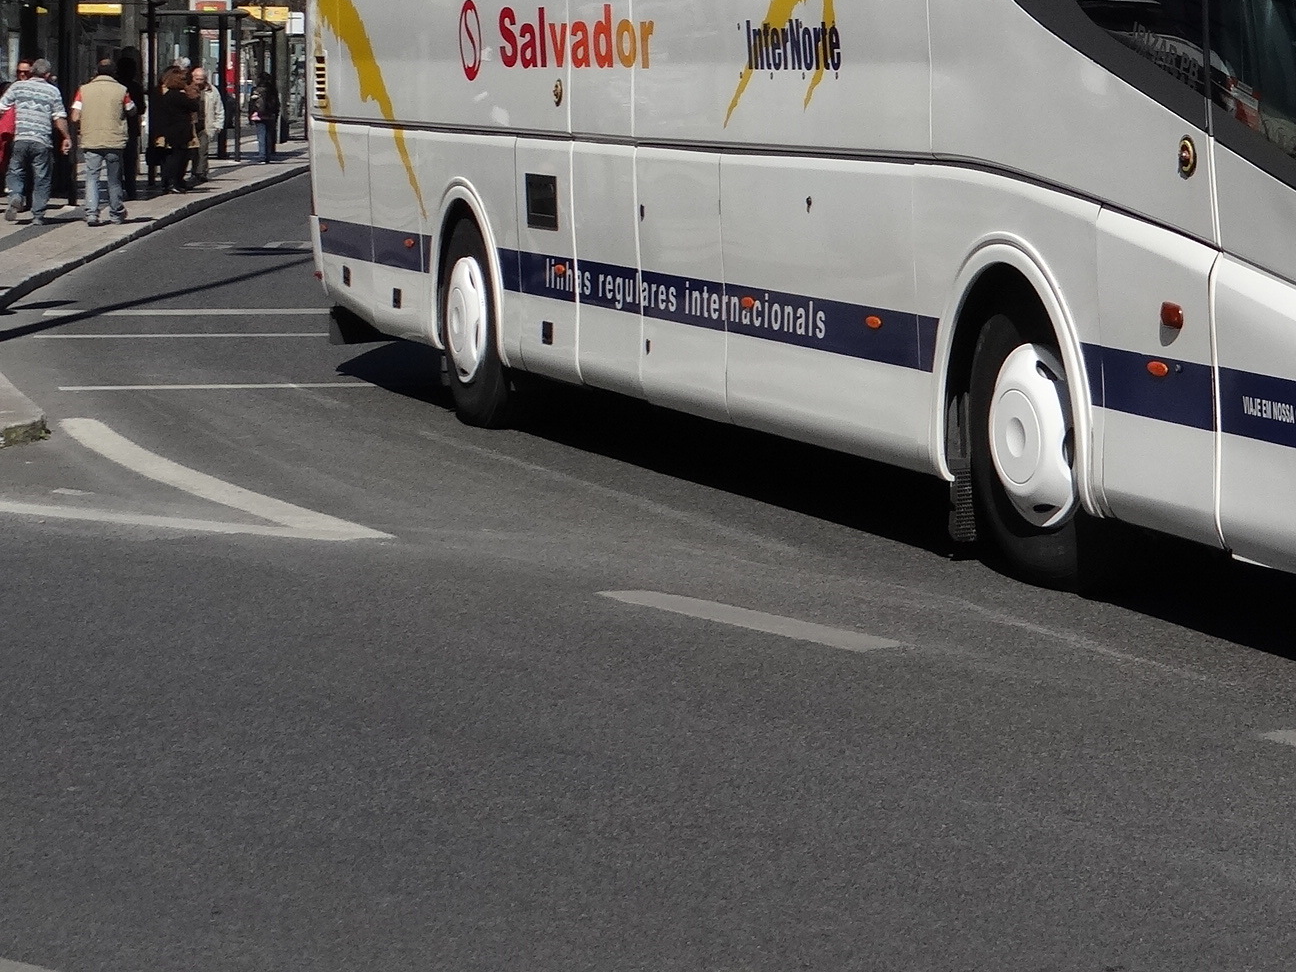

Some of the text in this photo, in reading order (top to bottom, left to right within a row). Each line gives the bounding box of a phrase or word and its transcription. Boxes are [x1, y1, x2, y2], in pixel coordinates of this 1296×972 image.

[499, 4, 655, 70] Salvador
[746, 18, 842, 72] InterNorte
[545, 258, 826, 339] linhas regulares internacionals
[1242, 395, 1261, 416] VIAJE
[1262, 399, 1272, 419] EM
[1272, 401, 1295, 424] NOSSA
